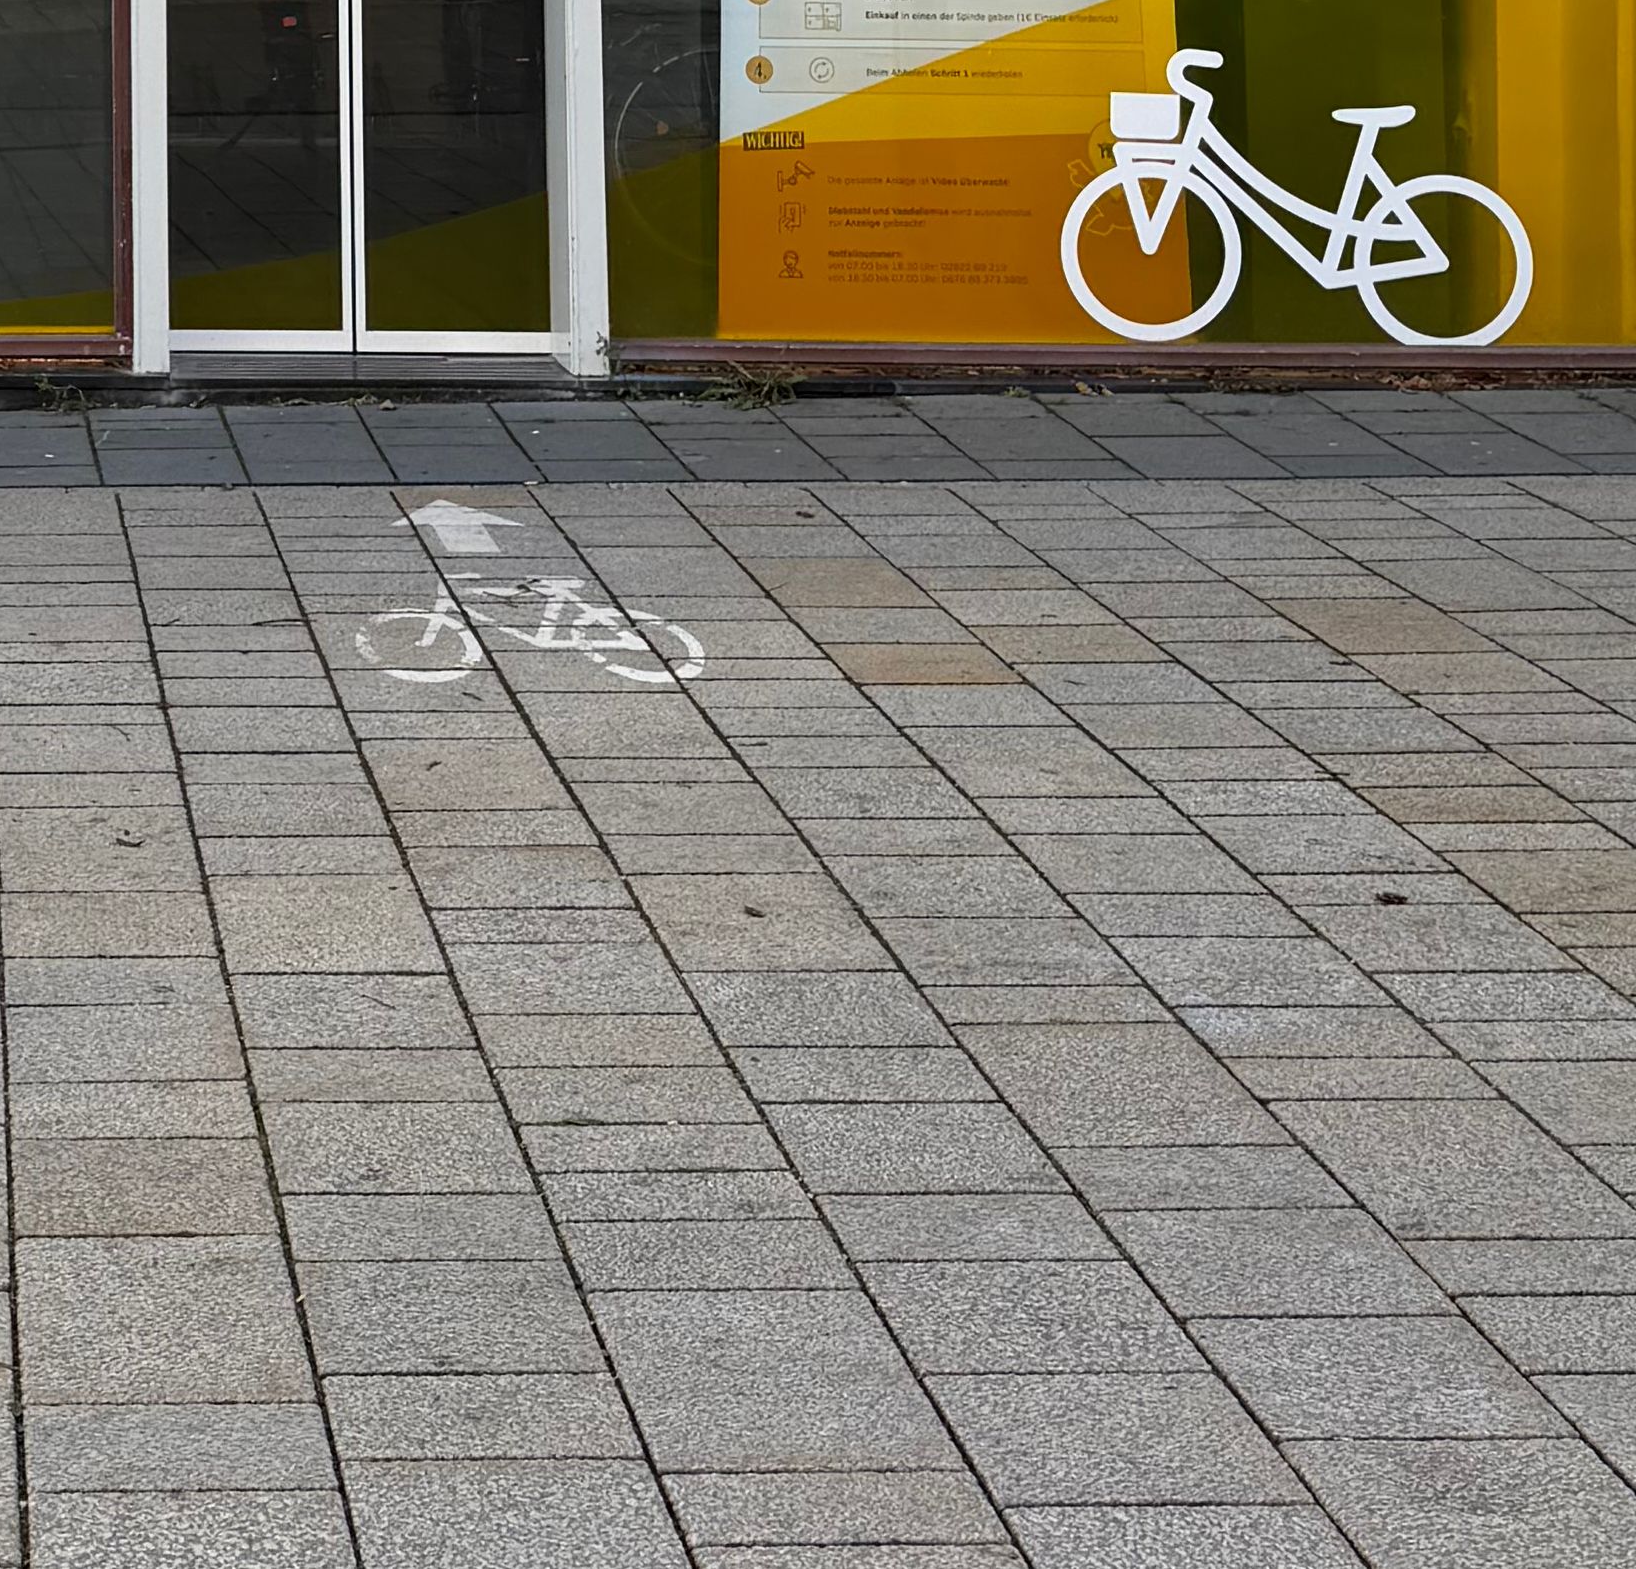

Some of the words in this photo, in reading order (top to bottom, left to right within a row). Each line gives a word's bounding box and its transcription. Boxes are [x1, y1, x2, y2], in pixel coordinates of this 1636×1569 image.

[865, 11, 899, 20] Einkauf
[901, 12, 910, 20] in
[939, 13, 954, 21] der
